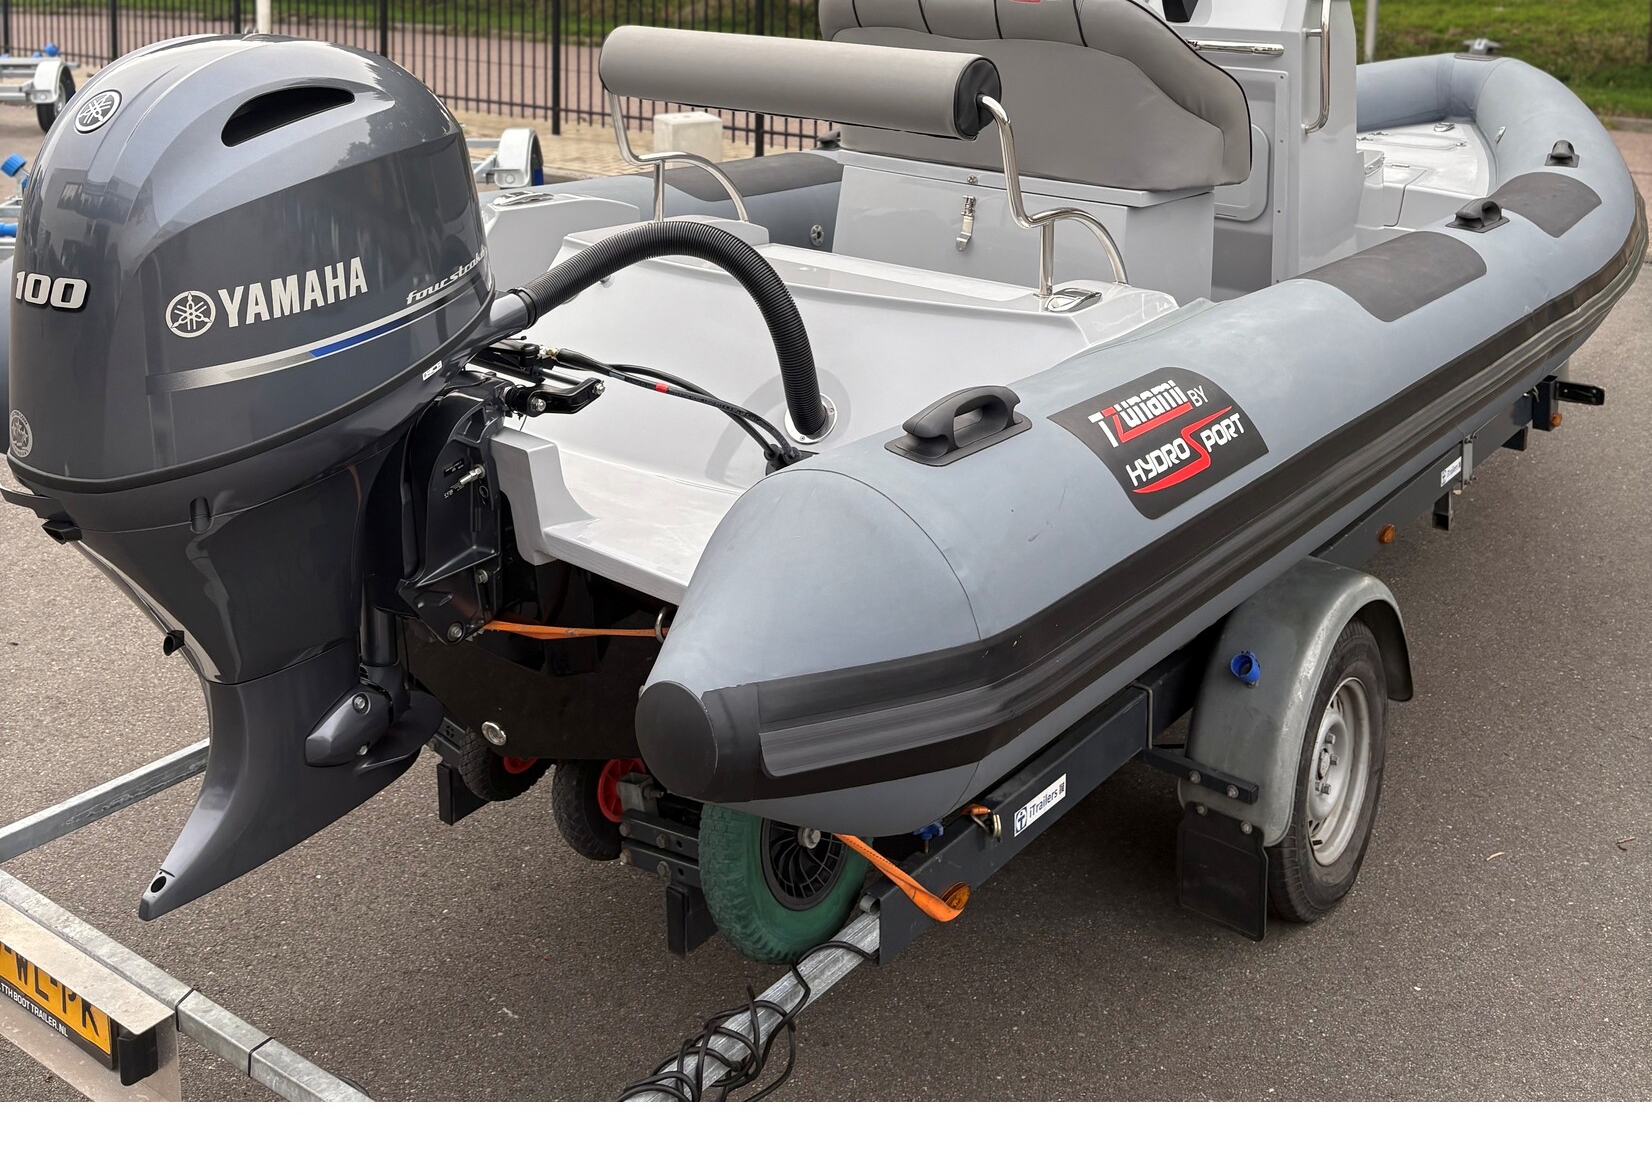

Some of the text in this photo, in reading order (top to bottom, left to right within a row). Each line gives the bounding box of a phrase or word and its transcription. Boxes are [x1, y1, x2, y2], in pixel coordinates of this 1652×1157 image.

[15, 271, 88, 309] 100
[217, 256, 369, 329] YAMAHA
[1186, 385, 1209, 408] BY
[13, 991, 30, 1010] BOOT
